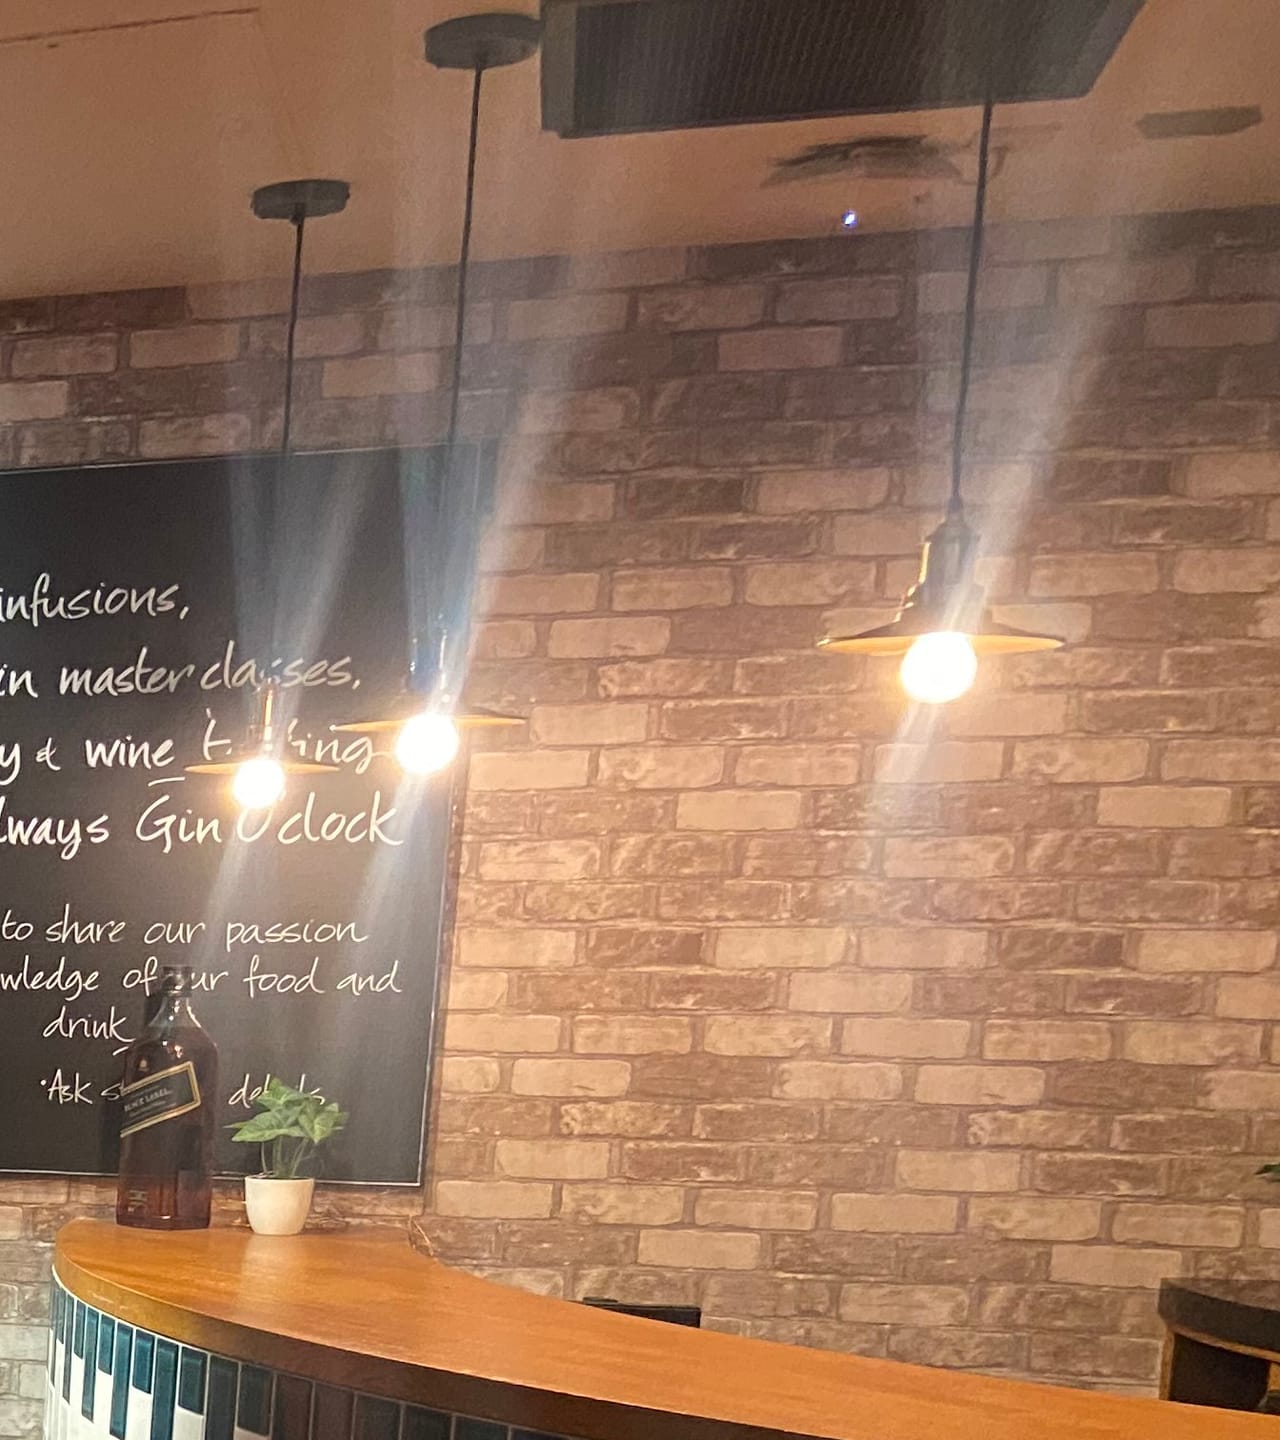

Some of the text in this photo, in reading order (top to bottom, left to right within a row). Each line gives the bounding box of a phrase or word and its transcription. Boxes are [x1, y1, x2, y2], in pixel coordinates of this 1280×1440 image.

[57, 645, 197, 697] master
[84, 734, 176, 770] wine
[135, 794, 223, 854] Gin
[2, 910, 35, 941] to
[45, 903, 127, 944] share
[143, 920, 207, 945] our
[225, 918, 369, 953] passion
[122, 955, 159, 998] of
[189, 968, 230, 992] ur
[242, 953, 326, 999] food
[335, 958, 403, 996] and
[42, 1004, 137, 1043] drink
[47, 1068, 94, 1105] Ask
